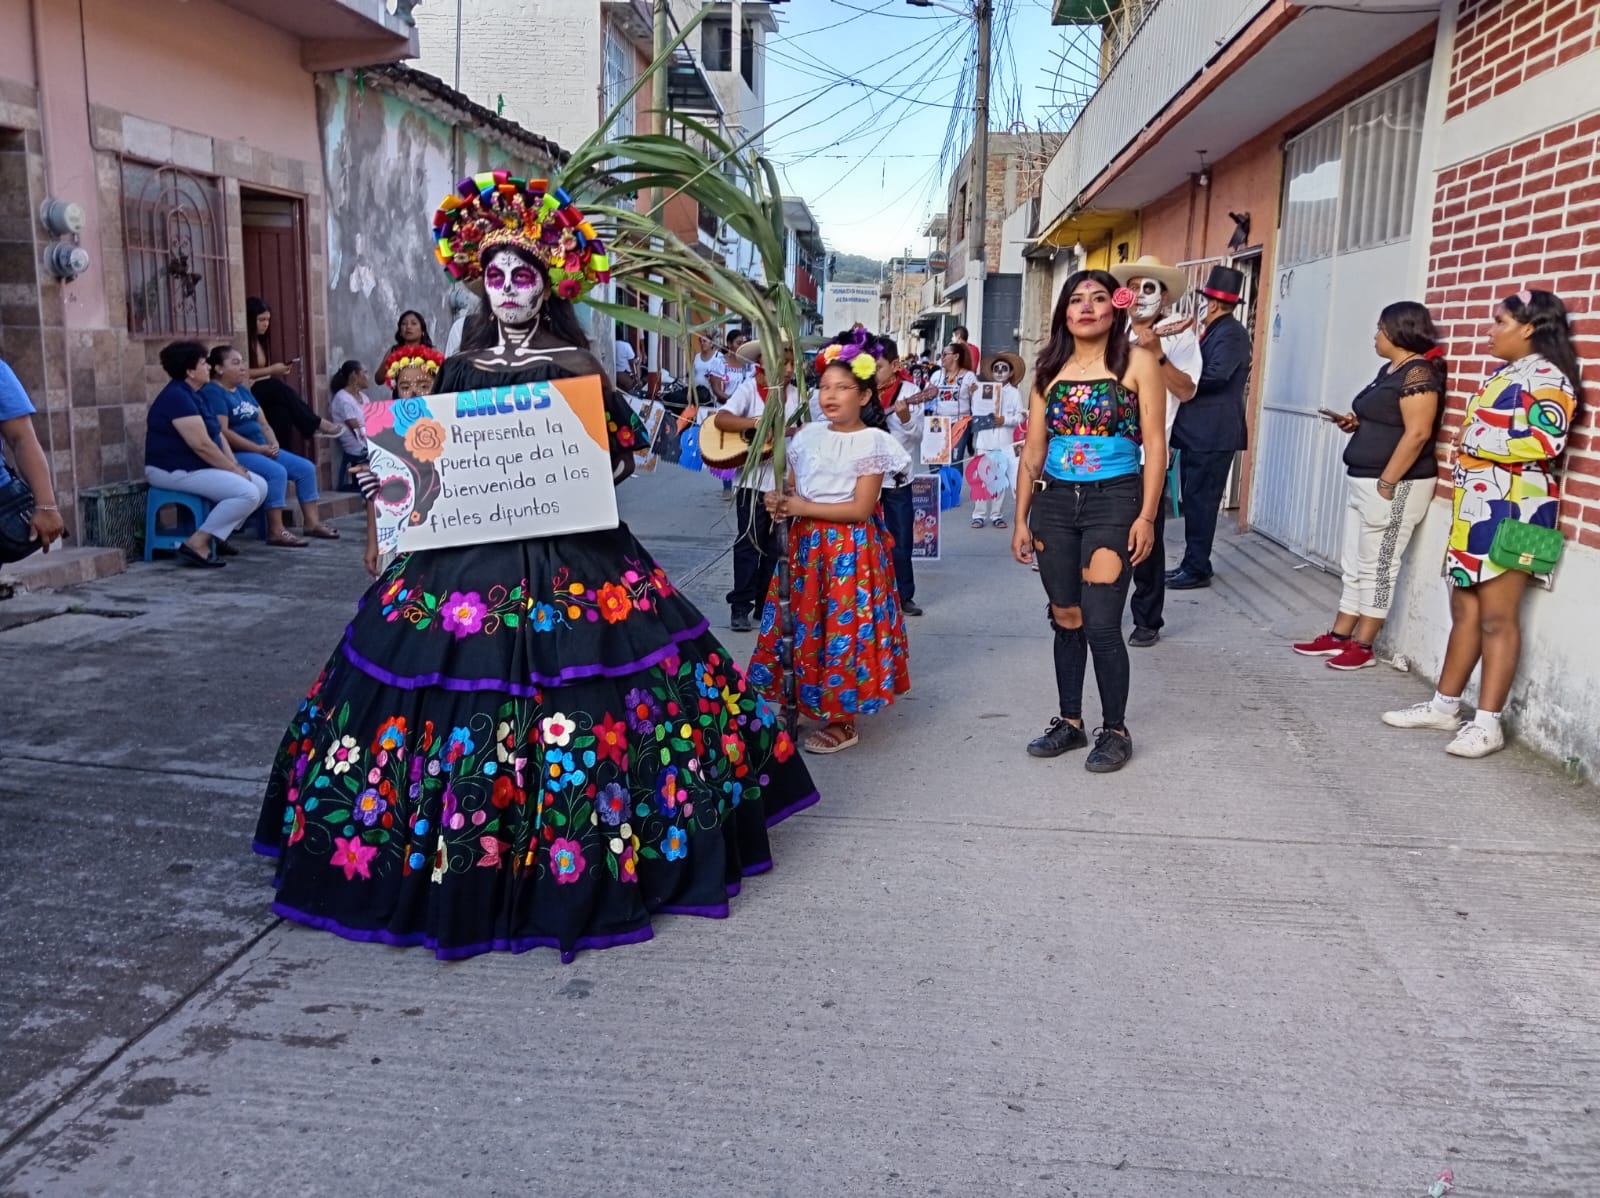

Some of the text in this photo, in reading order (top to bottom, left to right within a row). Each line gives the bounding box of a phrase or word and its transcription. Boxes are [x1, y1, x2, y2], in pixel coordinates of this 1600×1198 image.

[456, 381, 551, 418] ARCOS
[451, 418, 563, 450] Representa la
[441, 441, 579, 476] puerta que da la
[441, 465, 590, 498] bienvenida a los
[429, 498, 560, 532] fieles difuntos
